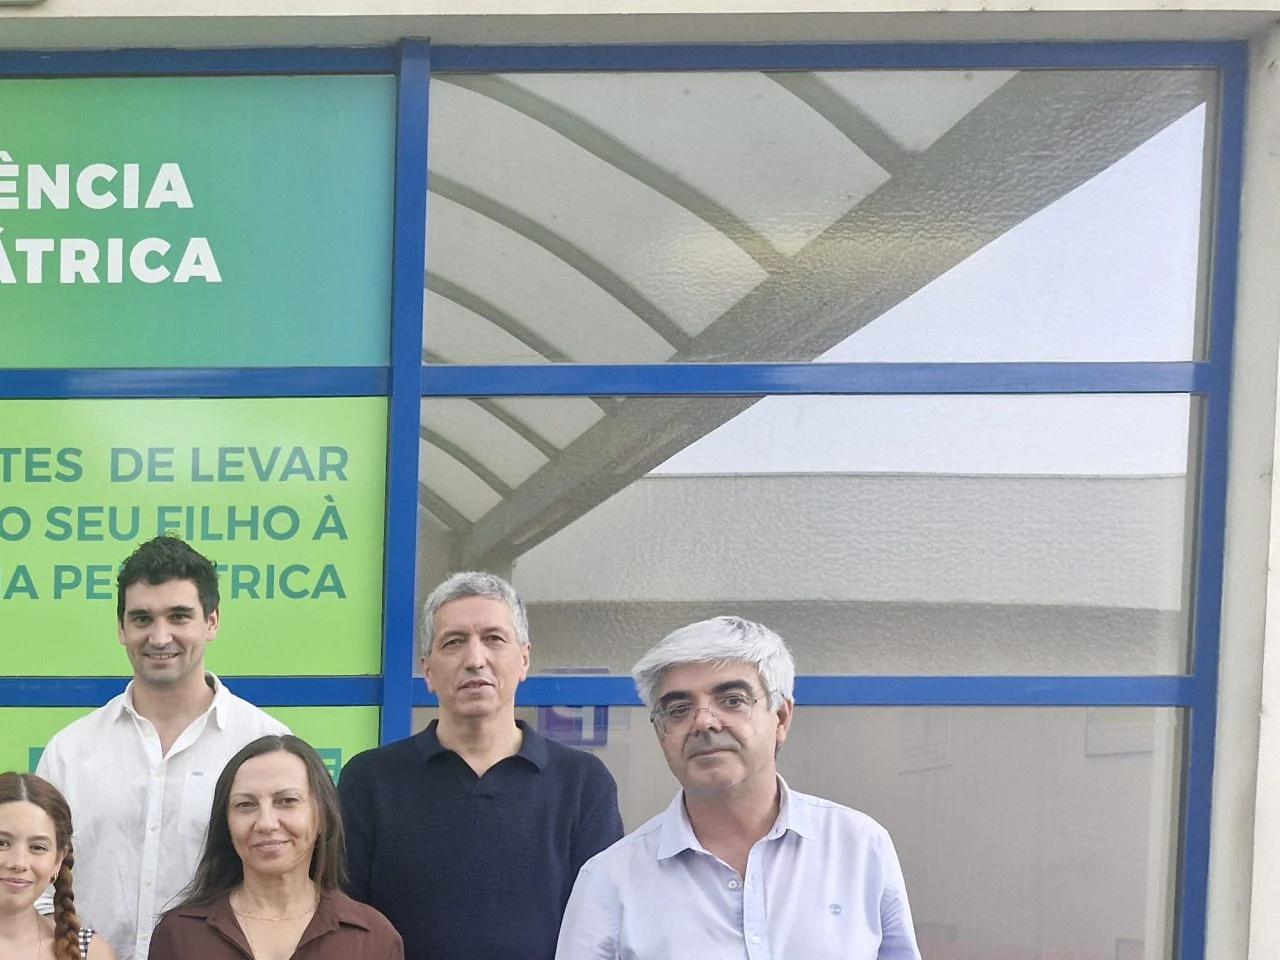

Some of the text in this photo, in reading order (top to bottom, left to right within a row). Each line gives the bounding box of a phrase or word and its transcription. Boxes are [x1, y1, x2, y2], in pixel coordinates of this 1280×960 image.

[110, 447, 175, 483] DE
[191, 446, 349, 482] LEVAR
[44, 505, 140, 541] SEU
[157, 505, 300, 541] FILHO
[312, 494, 349, 541] À
[53, 563, 348, 600] PERICA
